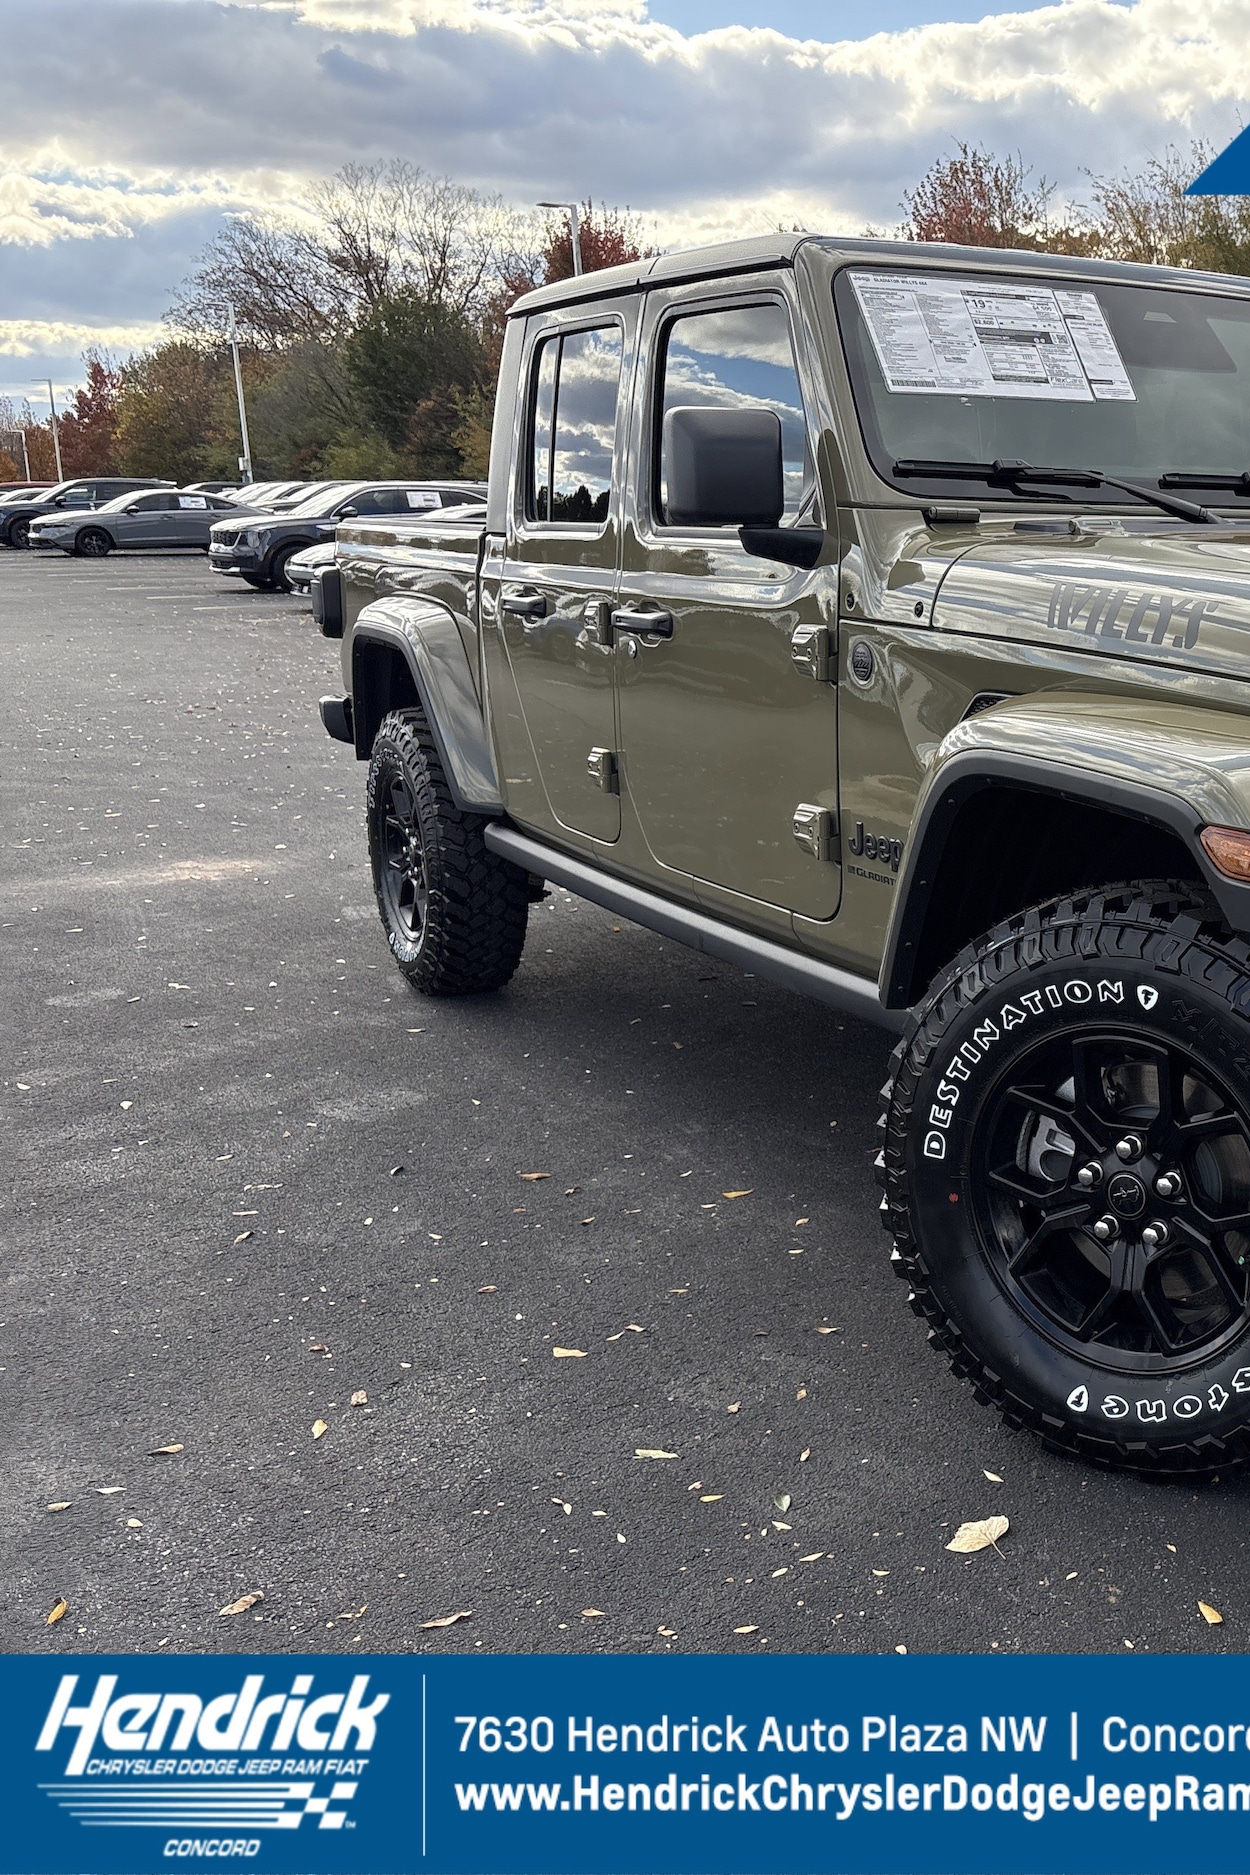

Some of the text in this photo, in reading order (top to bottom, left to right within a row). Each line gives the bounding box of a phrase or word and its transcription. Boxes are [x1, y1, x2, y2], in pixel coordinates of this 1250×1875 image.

[971, 299, 986, 309] 19
[1050, 376, 1084, 385] FlexCare
[1047, 581, 1220, 650] WILLYS
[847, 820, 905, 874] Jeep
[856, 867, 899, 887] GLADIAT
[923, 979, 1125, 1160] DESTINATION
